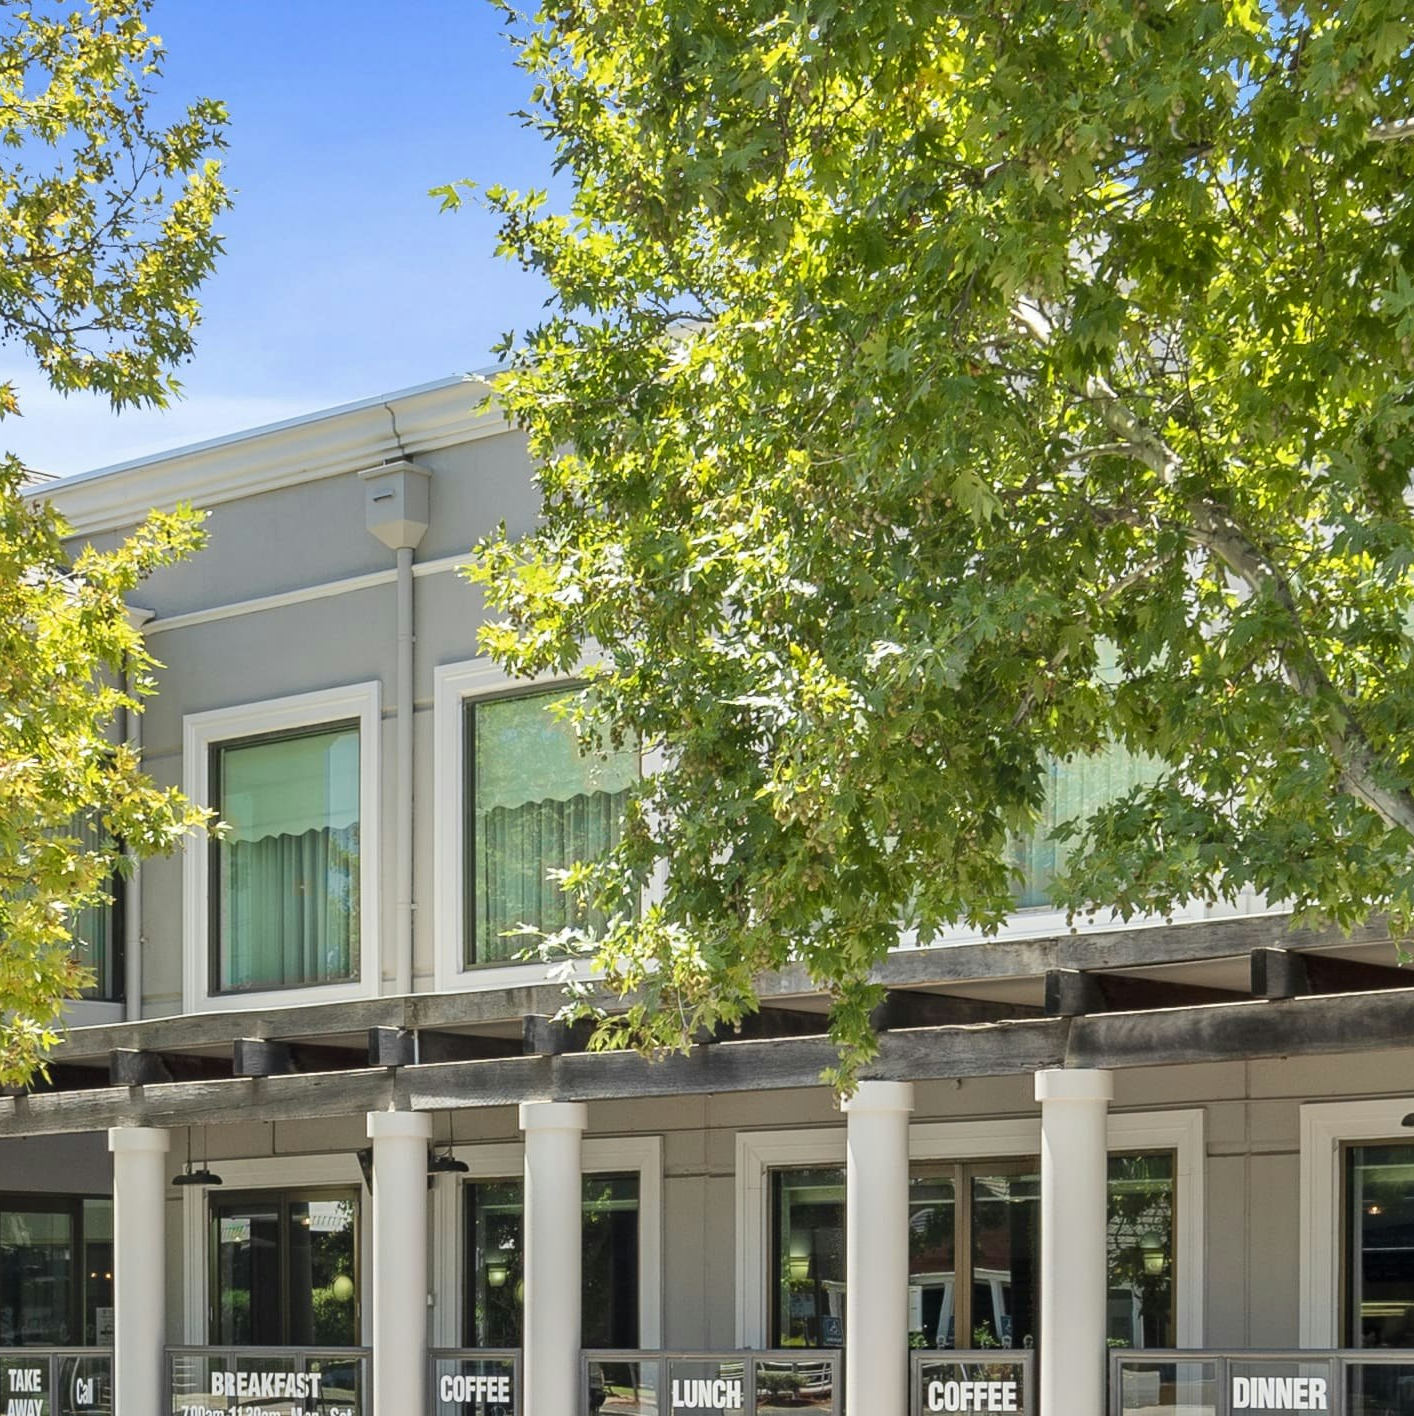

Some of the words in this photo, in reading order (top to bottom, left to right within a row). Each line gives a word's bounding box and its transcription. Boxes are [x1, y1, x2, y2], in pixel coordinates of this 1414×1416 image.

[8, 1368, 42, 1392] TAKE
[76, 1377, 94, 1405] Call
[211, 1371, 321, 1399] BREAKFAST
[440, 1374, 511, 1404] COFFEE
[672, 1379, 741, 1409] LUNCH
[1232, 1376, 1328, 1410] DINNER
[928, 1380, 1019, 1413] COFFEE
